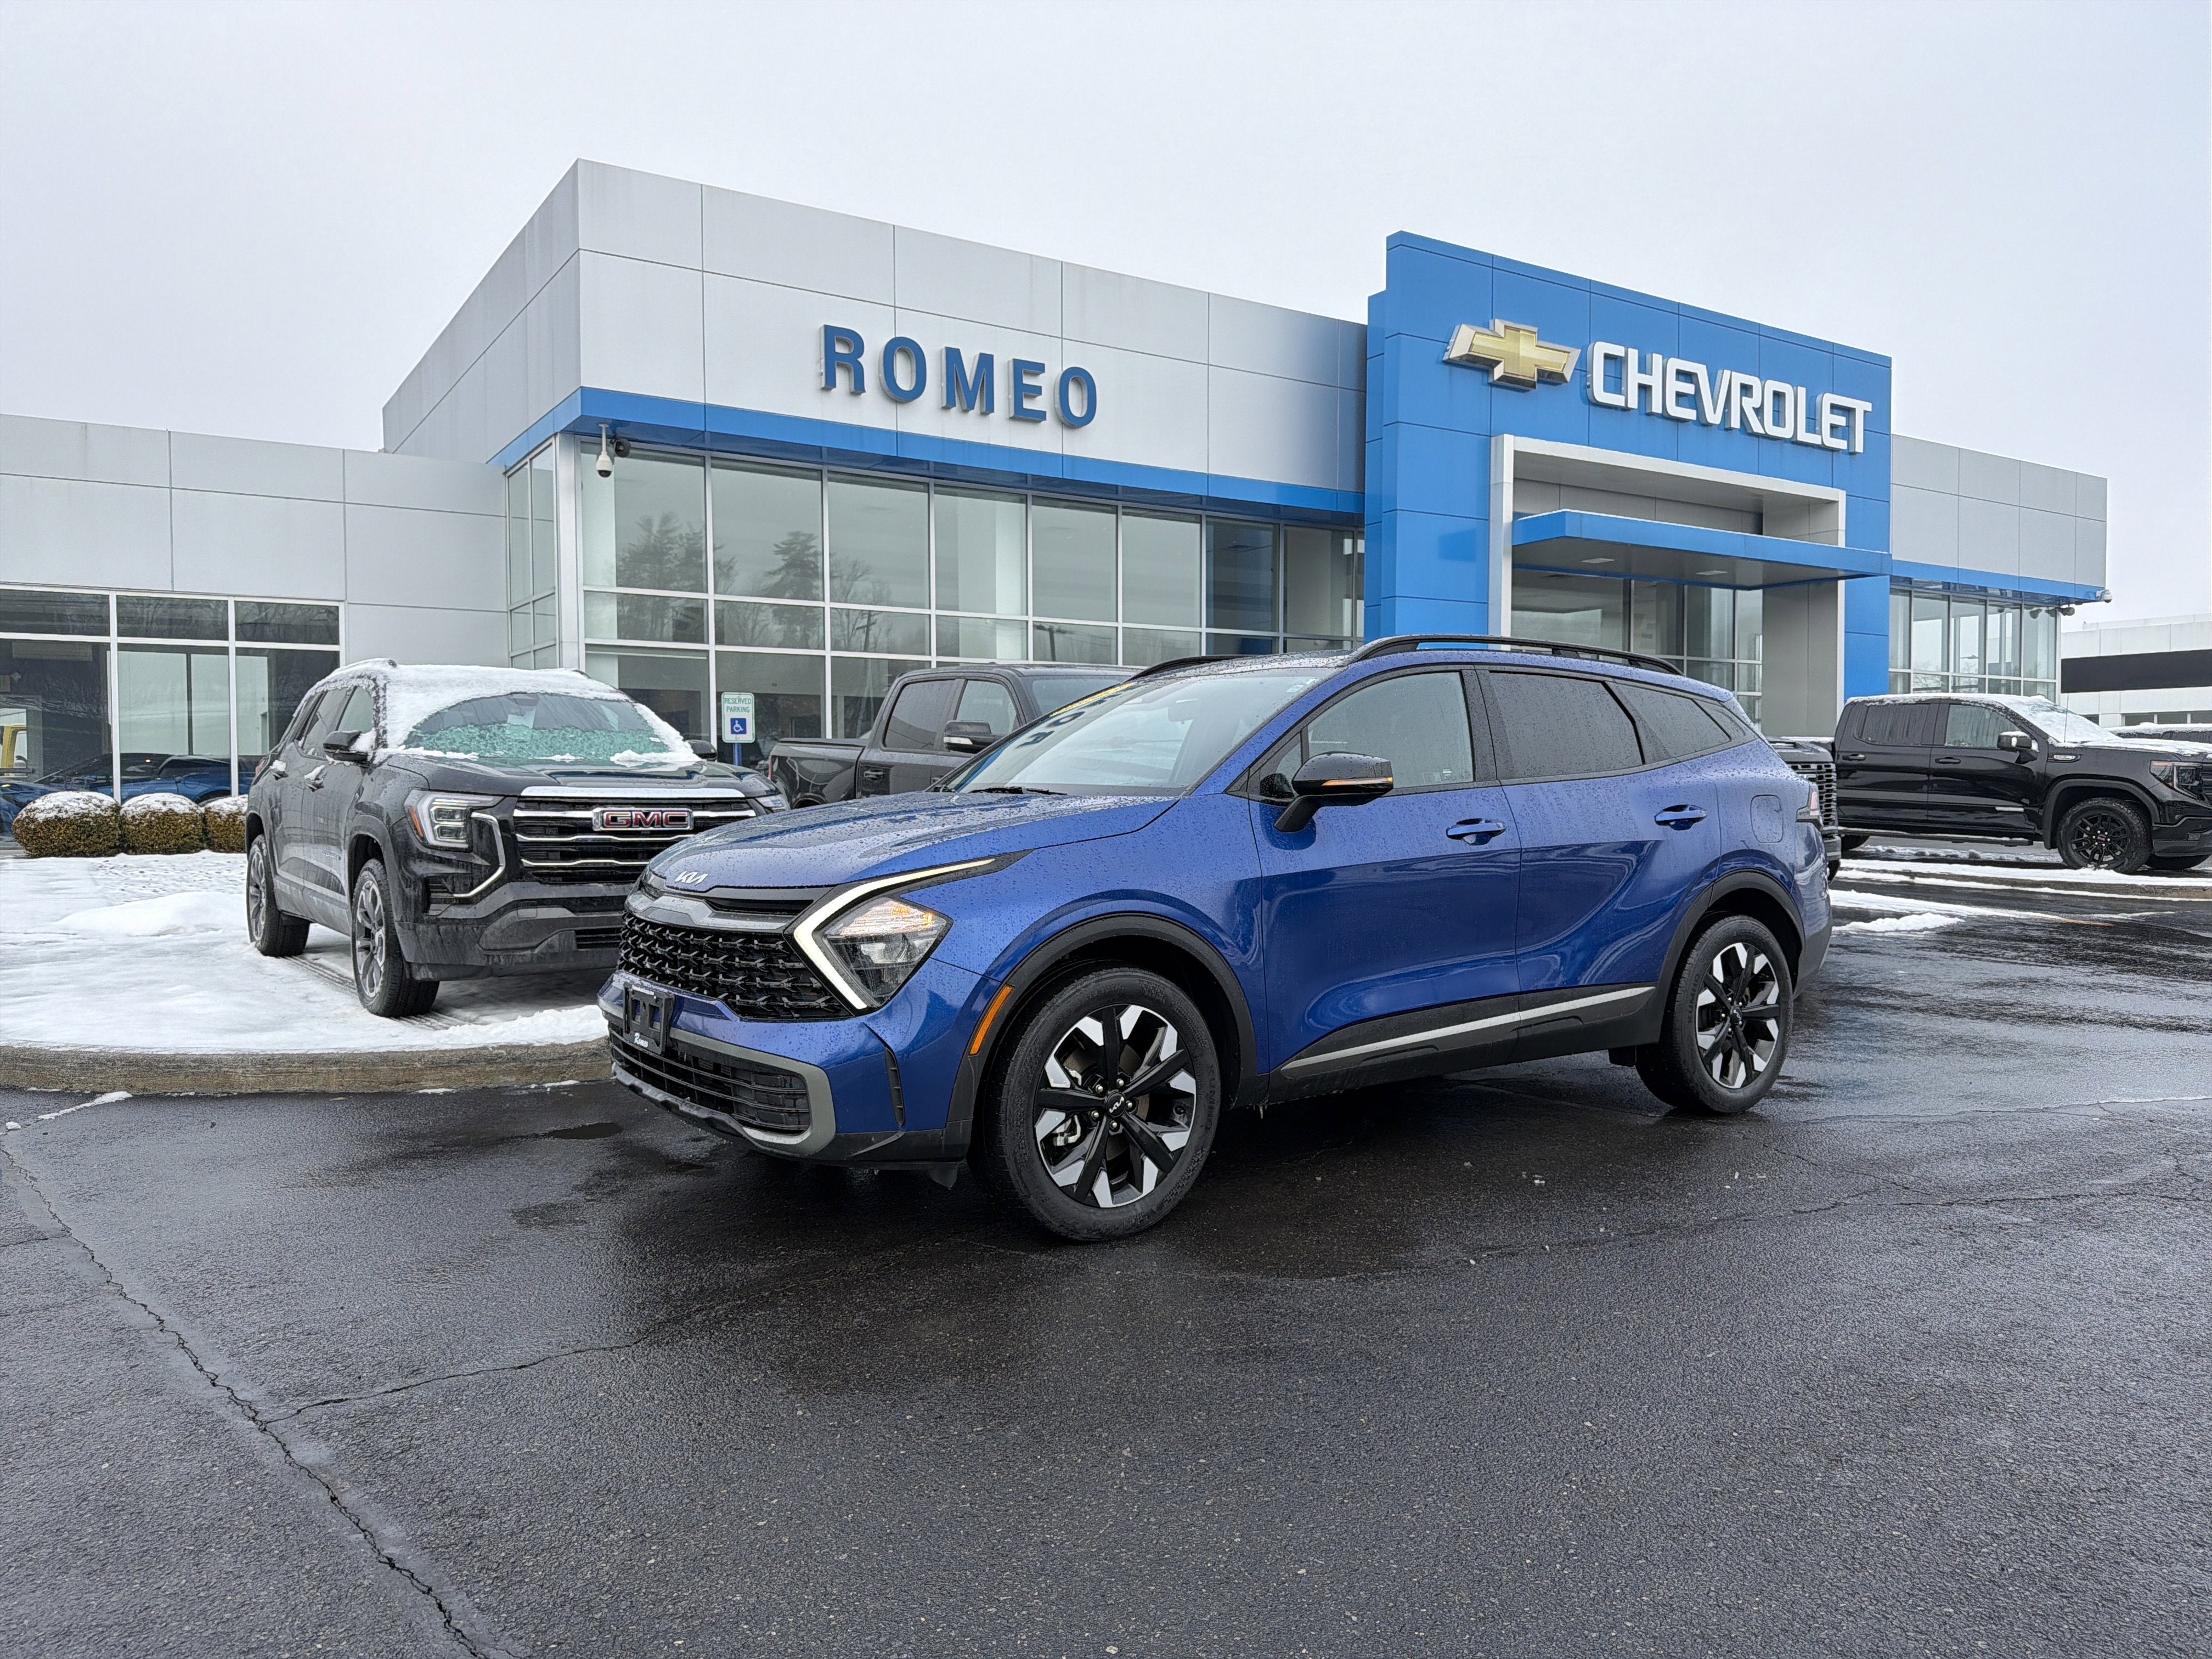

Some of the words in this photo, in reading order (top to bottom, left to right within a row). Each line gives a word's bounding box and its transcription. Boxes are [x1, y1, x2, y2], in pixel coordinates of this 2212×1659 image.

[820, 324, 1097, 427] ROMEO
[1587, 341, 1872, 453] CHEVROLET
[603, 811, 688, 827] GMC
